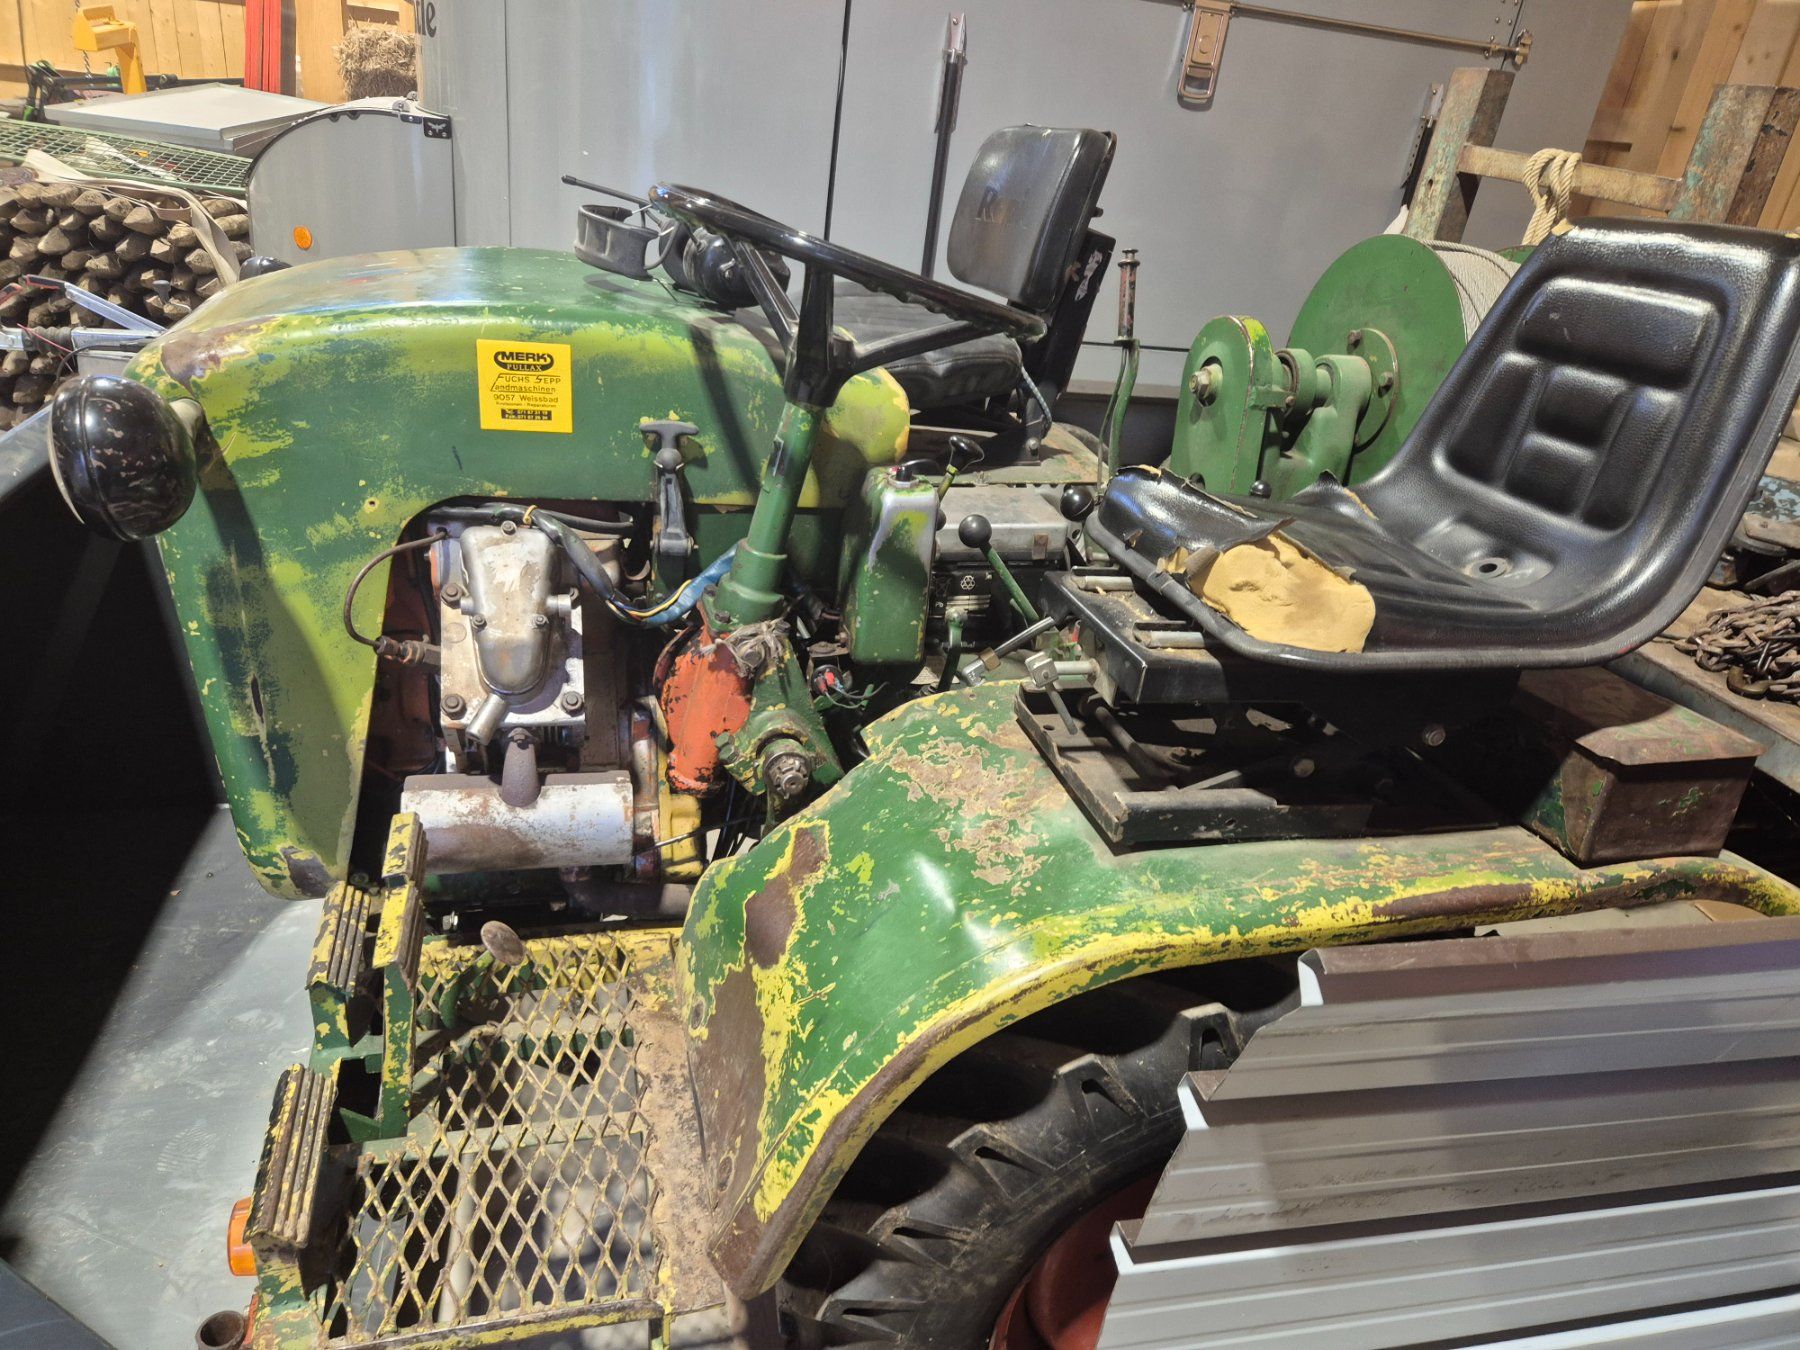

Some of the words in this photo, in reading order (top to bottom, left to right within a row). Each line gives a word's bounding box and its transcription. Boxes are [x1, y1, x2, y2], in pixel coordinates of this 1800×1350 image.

[501, 351, 548, 362] MERK
[507, 363, 542, 371] PULLAX
[498, 373, 530, 383] FUCHS
[493, 393, 515, 401] 9057
[519, 394, 559, 403] Weissbad
